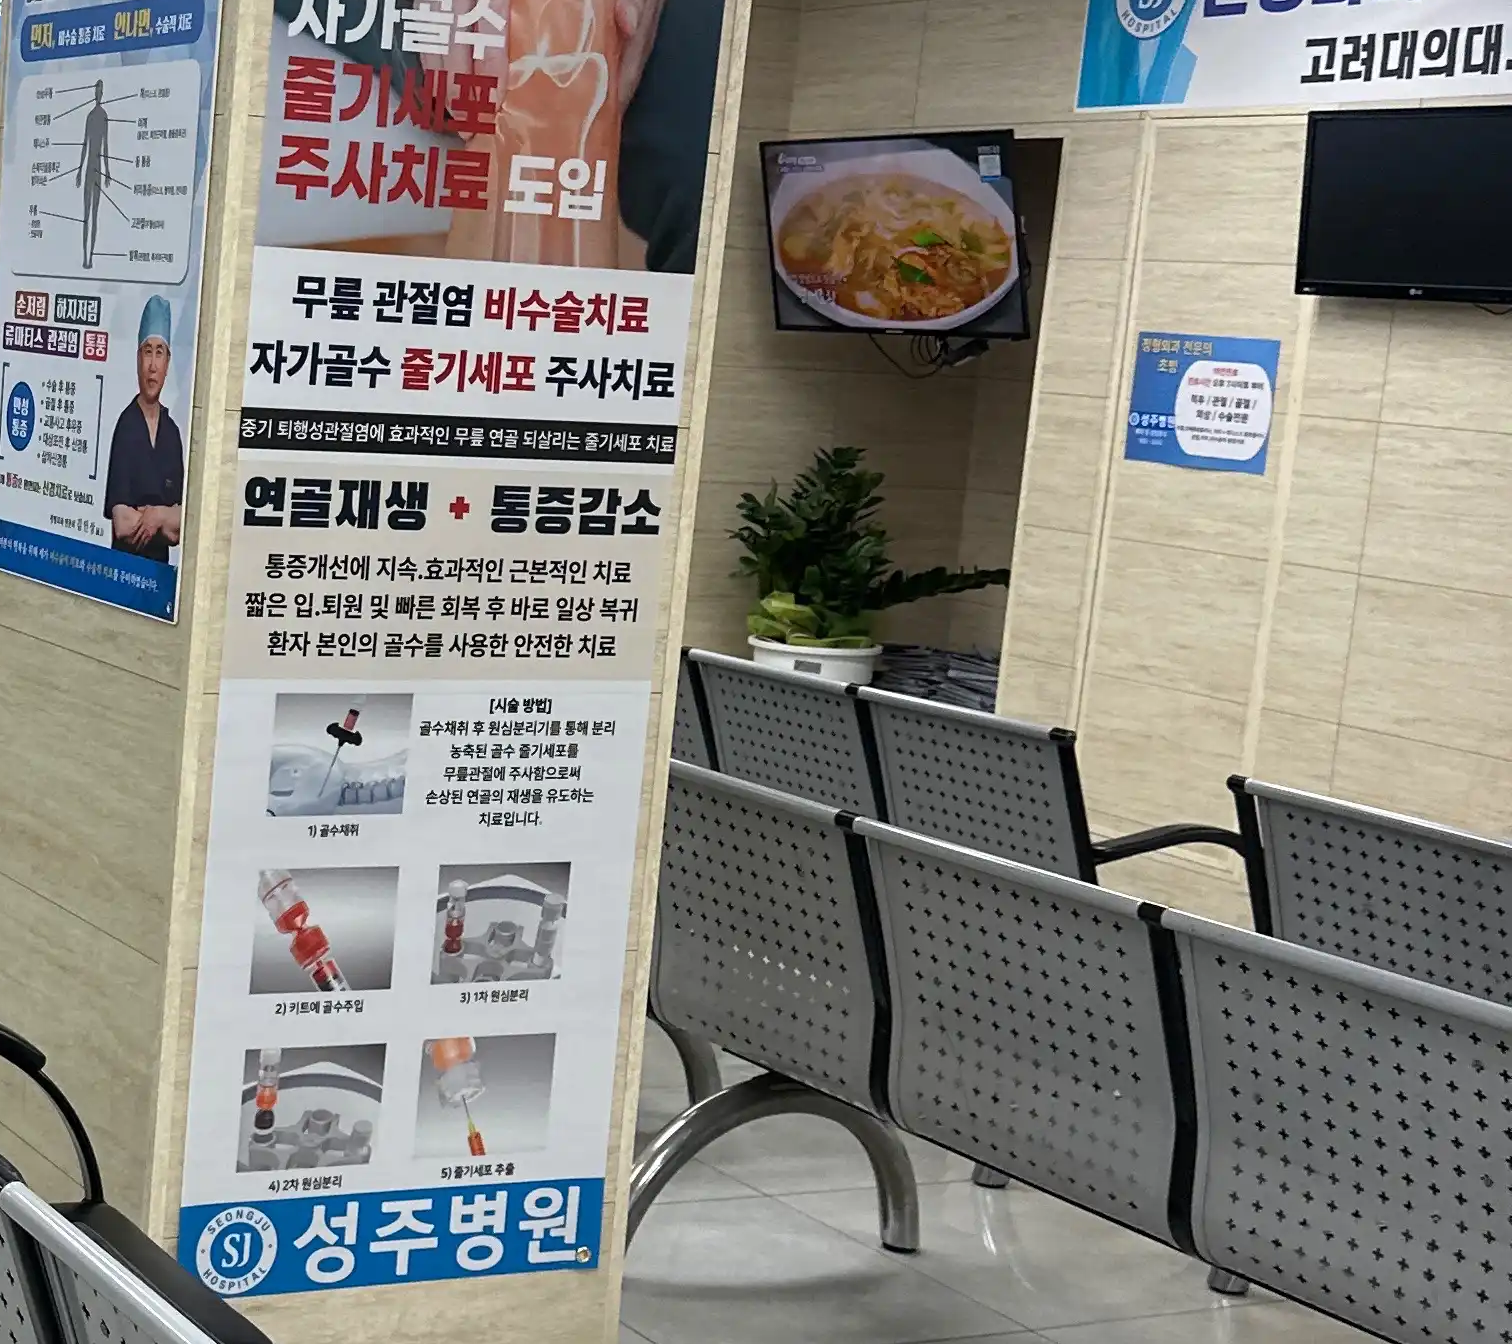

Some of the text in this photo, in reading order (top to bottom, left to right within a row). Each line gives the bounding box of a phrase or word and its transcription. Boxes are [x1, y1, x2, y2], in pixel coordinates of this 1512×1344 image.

[1121, 8, 1178, 35] HOSPITAL
[1300, 24, 1512, 85] 고려대의대
[282, 56, 499, 136] 줄기세포
[275, 135, 607, 221] 주사치료 도입
[16, 295, 98, 323] 손저림 하지저림
[292, 275, 649, 336] 무릎 관절염 비수술치료
[5, 325, 107, 357] 류마티스 관절염 통풍
[249, 340, 675, 401] 자가골수 줄기세포 주사치료
[240, 418, 675, 454] 중기 퇴행성관절염에 효과적인 무릎 연골 되살리는 줄기세포 치료
[243, 475, 662, 536] 연골재생 통증감소
[264, 553, 632, 585] 통증개선에 지속.효과적인 근본적인 치료
[244, 592, 639, 624] 짧은 입.퇴원 및 빠른 회복 후 바로 일상 복귀
[267, 631, 617, 658] 환자 본인의 골수를 사용한 안전한 치료
[489, 698, 552, 715] [시술 방법]
[419, 720, 616, 737] 골수채취 후 원심분리기를 통해 분리
[450, 743, 579, 760] 농축된 골수 줄기세포를
[443, 765, 581, 783] 무릎관절에 주사함으로써
[425, 788, 594, 806] 손상된 연골의 재생을 유도하는
[308, 823, 359, 839] 1) 골수채취
[479, 812, 543, 828] 치료입니다.
[275, 1002, 287, 1016] 2)
[322, 999, 364, 1015] 골수주입
[460, 988, 529, 1005] 3) 1차 원심분리
[269, 1175, 343, 1194] 4) 2차 원심분리
[441, 1162, 515, 1180] 5) 줄기세포 추출
[206, 1209, 272, 1236] SEONGJU
[293, 1185, 581, 1284] 성주병원
[221, 1232, 253, 1269] SJ
[202, 1266, 269, 1292] HOSPITAL
